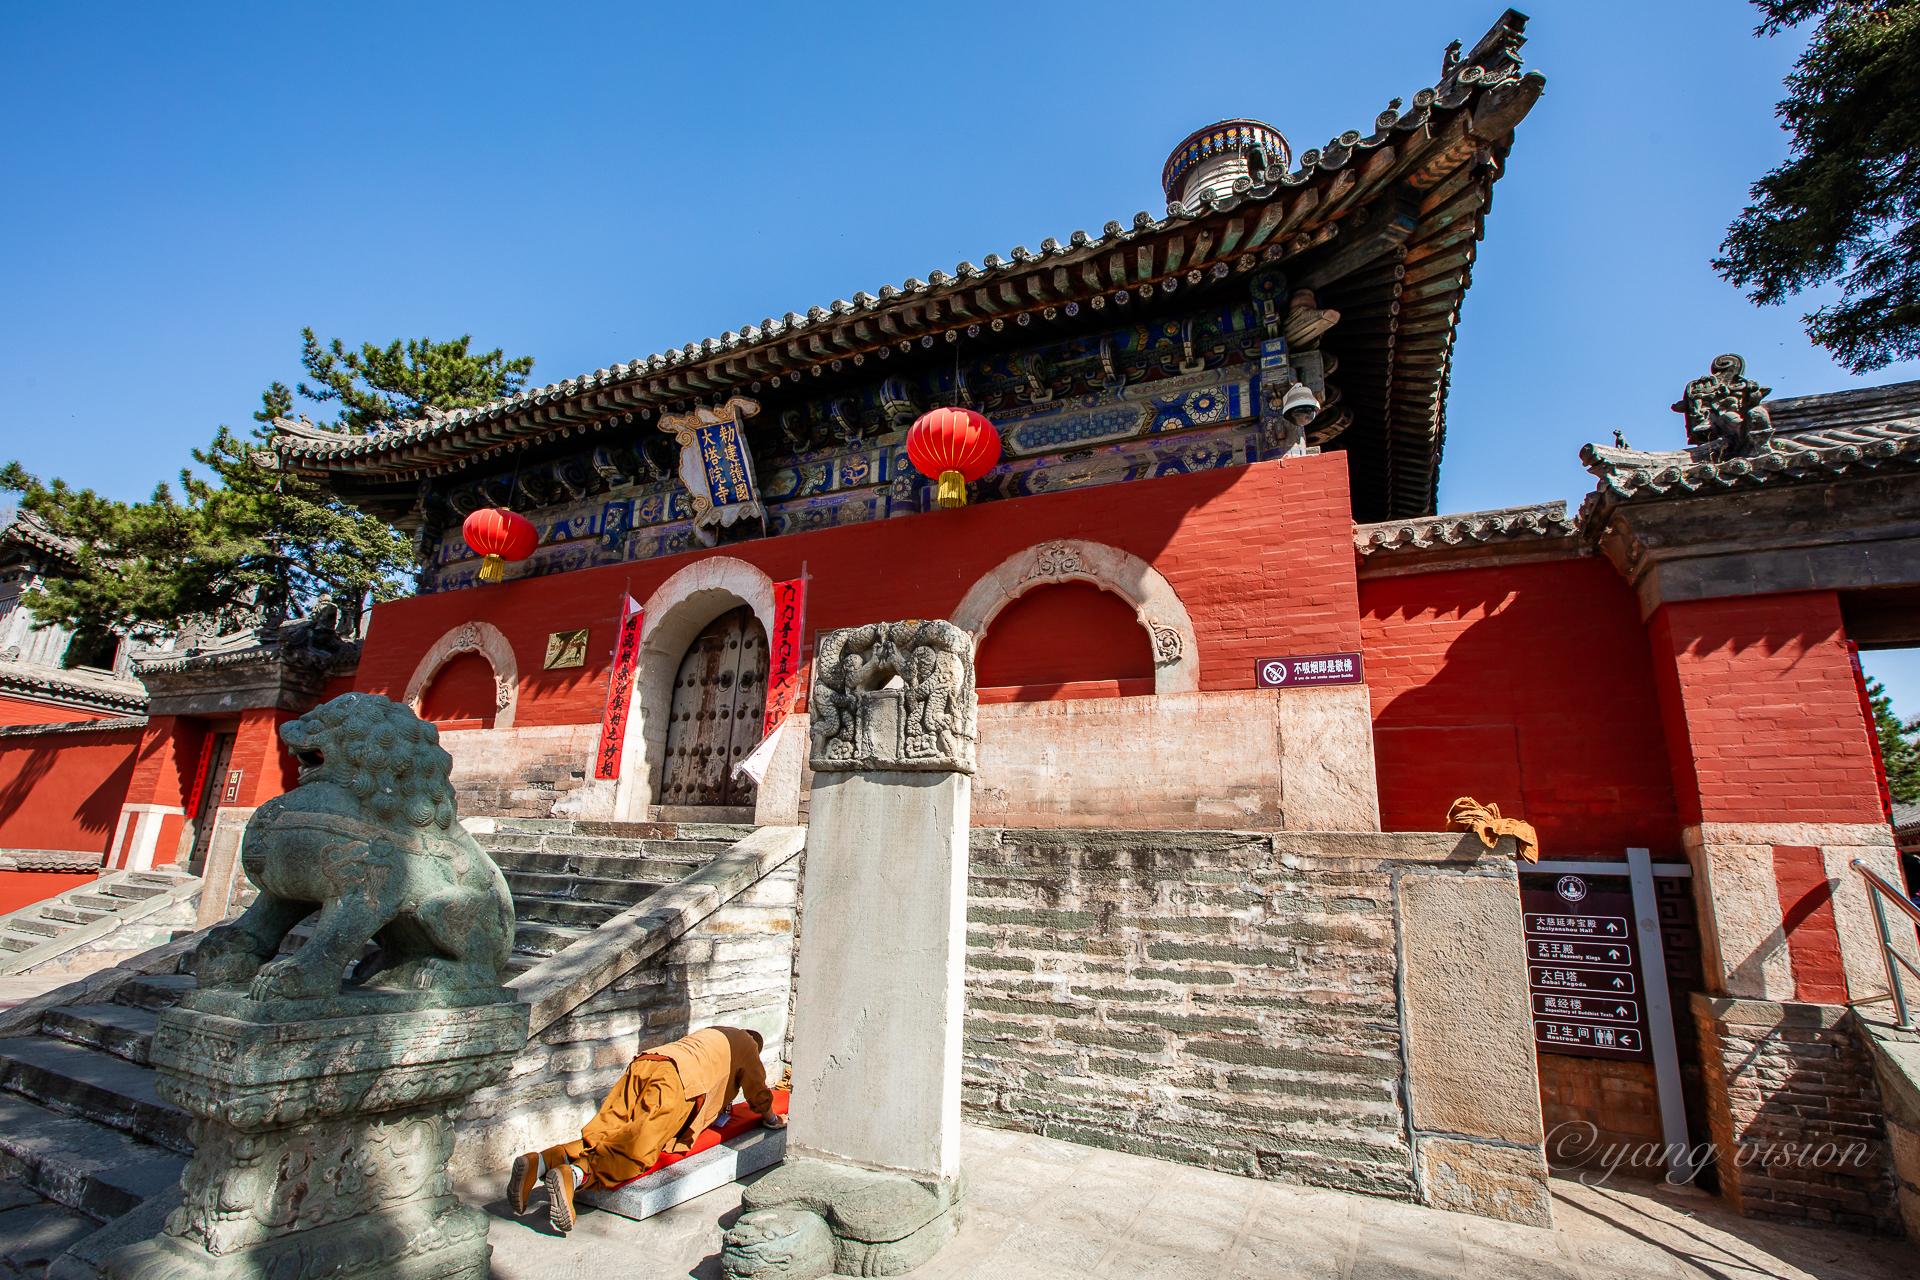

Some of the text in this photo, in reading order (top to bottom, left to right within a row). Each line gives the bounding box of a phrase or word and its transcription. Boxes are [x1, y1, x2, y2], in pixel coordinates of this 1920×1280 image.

[702, 429, 729, 504] 大塔院寺
[1294, 659, 1352, 674] 不吸烟即是敬佛
[1536, 917, 1597, 928] 大慈延寿宝殿
[1538, 943, 1574, 955] 天王殿
[1541, 969, 1578, 982] 大白塔
[1544, 997, 1582, 1010] 藏经楼
[1544, 1007, 1571, 1015] Depository
[1546, 1024, 1590, 1039] 卫生间
[1546, 1034, 1580, 1042] Restroom
